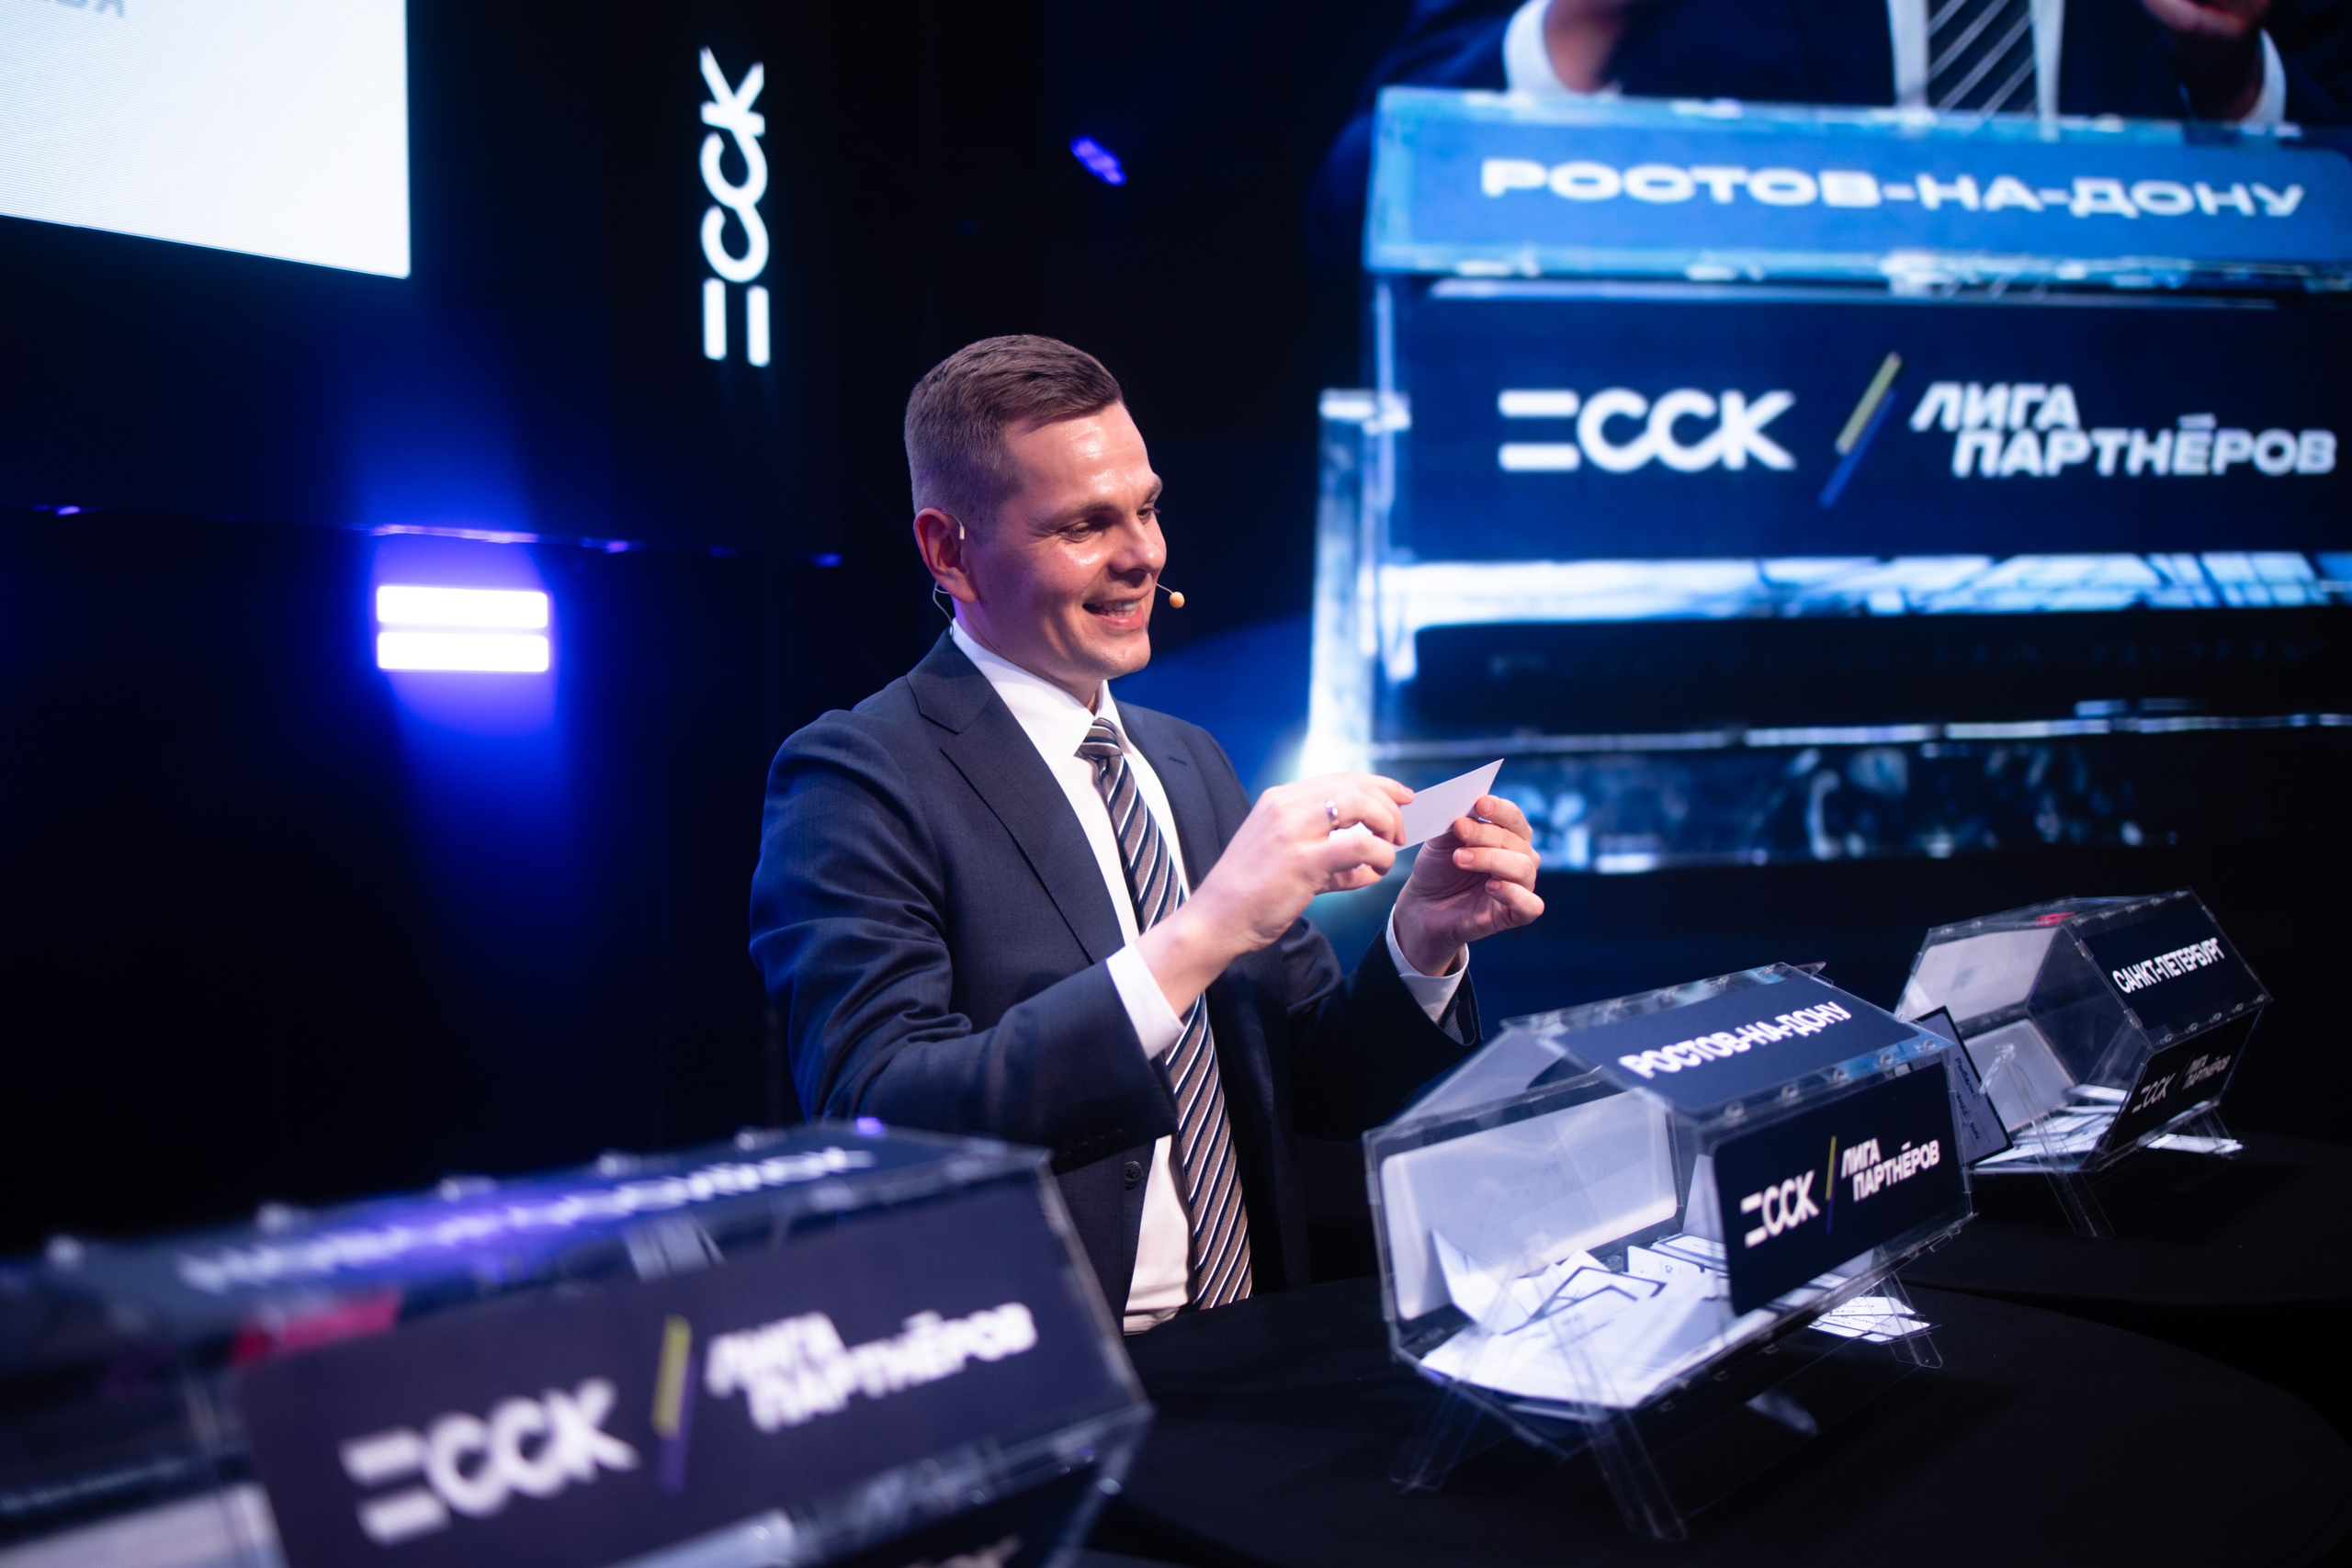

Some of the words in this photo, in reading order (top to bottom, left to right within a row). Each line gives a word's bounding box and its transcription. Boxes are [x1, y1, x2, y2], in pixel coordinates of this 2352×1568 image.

[1910, 381, 2080, 431] ЛИГА
[2112, 937, 2224, 993] САНКТ-ПЕТЕРБУРГ
[1618, 1001, 1851, 1079] РОСТОВ-НА-ДОНУ
[1841, 1138, 1882, 1179] ЛИГА
[1853, 1140, 1940, 1202] ПАРТНЁРОВ
